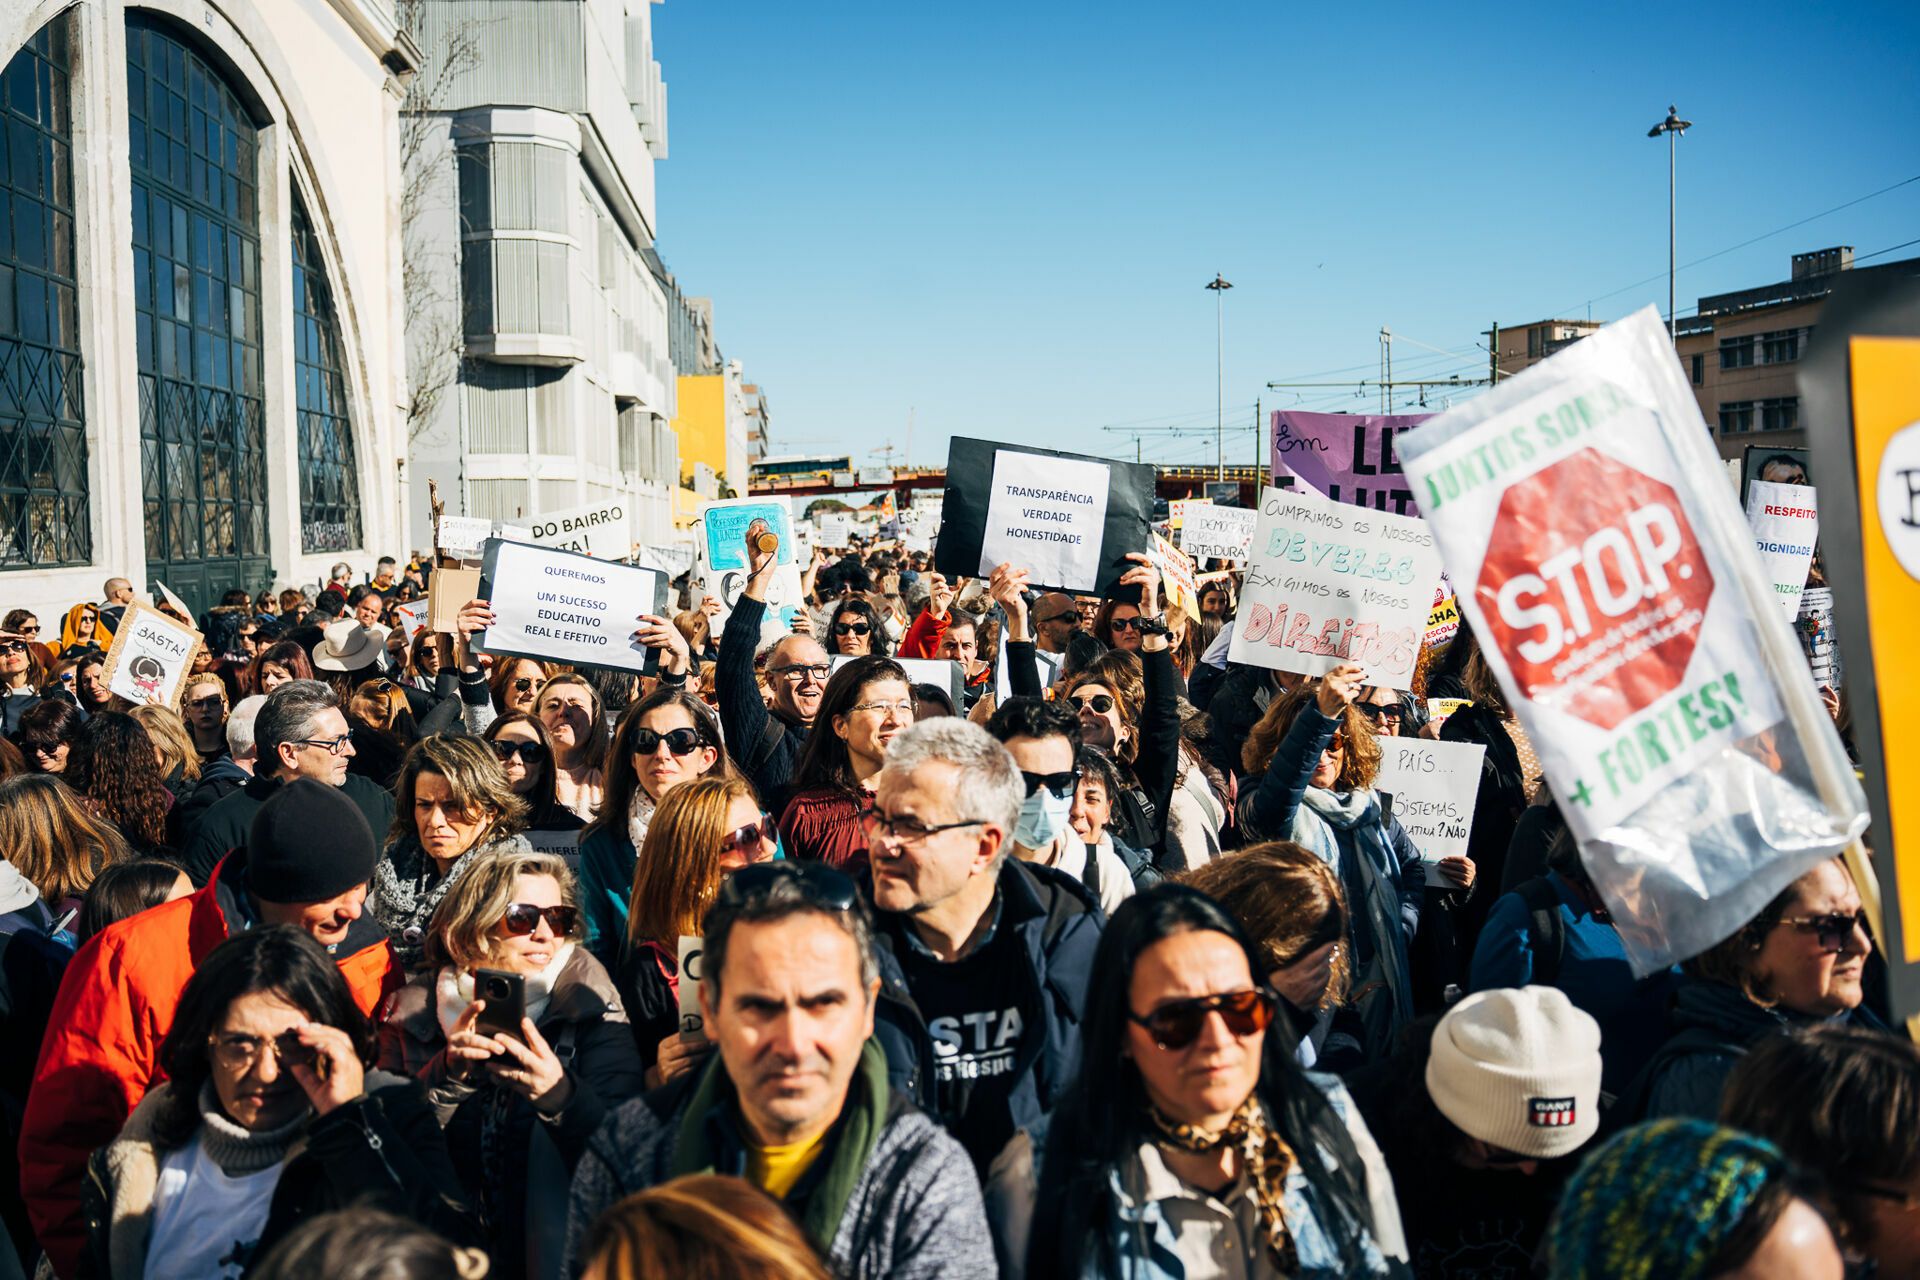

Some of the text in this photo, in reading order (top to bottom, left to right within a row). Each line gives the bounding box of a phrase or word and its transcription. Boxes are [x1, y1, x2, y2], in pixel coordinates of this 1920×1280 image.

[1276, 424, 1329, 453] Em
[1006, 485, 1094, 505] TRANSPARÊNCIA
[1022, 508, 1073, 523] VERDADE
[1764, 504, 1817, 520] RESPEITO
[532, 522, 558, 539] DO
[562, 506, 623, 533] BAIRRO
[1006, 527, 1082, 545] HONESTIDADE
[1354, 521, 1370, 534] OS
[1381, 525, 1433, 547] NOSSOS
[1187, 543, 1246, 558] DITADURA
[1756, 540, 1811, 557] DIGNIDADE
[544, 565, 606, 585] QUEREMOS
[1497, 502, 1693, 664] S.T.O.P.
[537, 591, 608, 611] UM SUCESSO
[1361, 587, 1410, 610] NOSSOS
[537, 608, 602, 628] EDUCATIVO
[1427, 608, 1457, 626] CHA
[525, 624, 608, 646] REAL E EFETIVO
[1425, 622, 1458, 640] ESCOLA
[136, 626, 186, 657] BASTA!
[1598, 677, 1749, 797] FORTES!
[1445, 817, 1467, 839] NÃO
[537, 846, 582, 856] QUERE
[928, 1006, 1024, 1057] STA
[955, 1055, 1016, 1079] Respe
[1535, 1100, 1572, 1112] GANT
